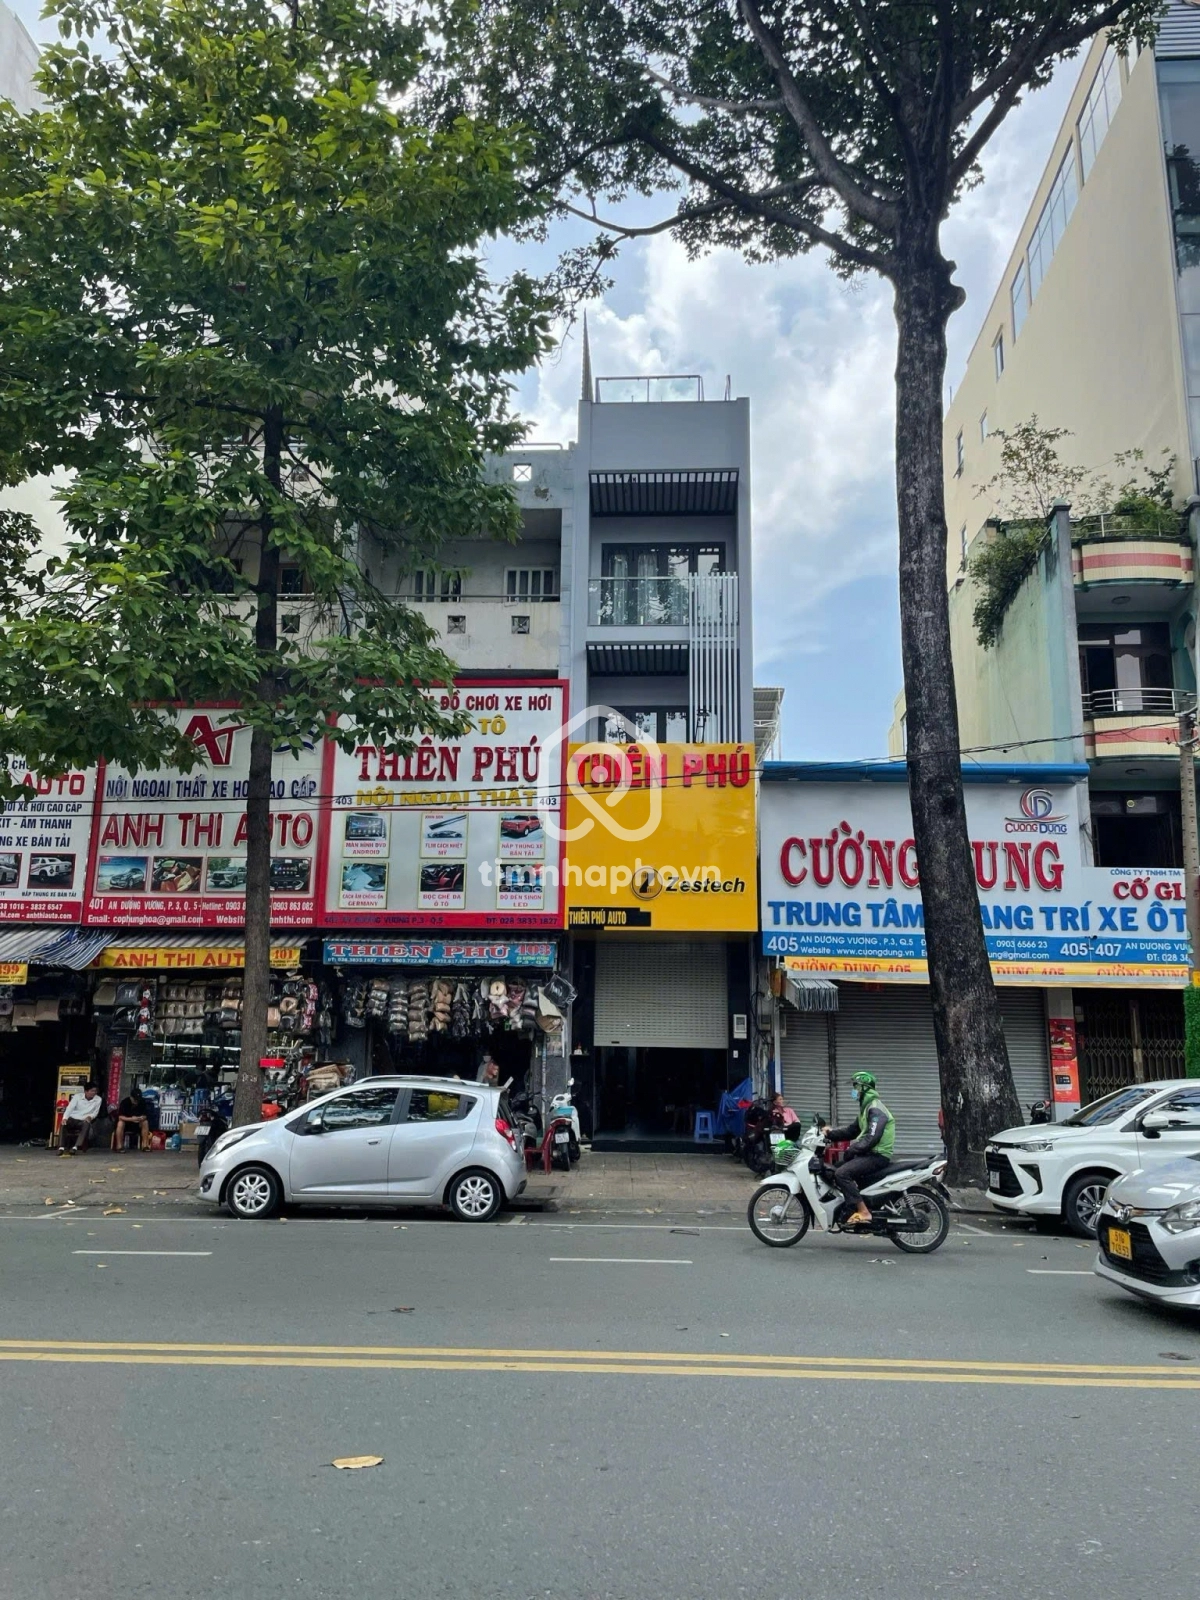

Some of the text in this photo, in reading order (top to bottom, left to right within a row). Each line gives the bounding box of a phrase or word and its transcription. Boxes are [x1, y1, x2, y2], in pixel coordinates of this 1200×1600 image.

[440, 689, 460, 711] ĐỒ
[466, 694, 500, 711] CHƠI
[505, 696, 523, 711] XE
[528, 694, 552, 711] HƠI
[478, 714, 507, 735] TÔ
[355, 735, 542, 783] THIÊN PHÚ
[573, 745, 751, 788] THIÊN PHÚ
[176, 774, 208, 798] THẤT
[212, 780, 228, 798] XE
[269, 780, 286, 799] AO
[334, 784, 557, 809] 403 NỘI NGOẠI THẤT 403
[18, 802, 29, 812] XE
[31, 803, 45, 812] HƠI
[47, 803, 63, 813] CAO
[21, 816, 72, 830] ÂM THANH
[101, 813, 164, 847] ANH
[178, 812, 222, 847] THI
[15, 837, 29, 848] XE
[55, 833, 71, 848] TẢI
[780, 821, 1065, 892] CƯỜNG UNG
[1110, 868, 1132, 876] CÔNG
[665, 875, 746, 894] Zestech
[1112, 877, 1187, 900] CỐ GI
[30, 903, 46, 911] 3832
[89, 898, 104, 910] 401
[108, 901, 118, 910] AN
[168, 901, 174, 910] P.
[175, 901, 181, 911] 3,
[184, 901, 191, 911] Q.
[193, 902, 198, 910] 5
[202, 902, 224, 910] Hotline:
[225, 902, 242, 911] 0903
[273, 902, 314, 911] 0903 863 082
[87, 914, 111, 923] Email:
[113, 915, 204, 925] cophunghoa@gmail.com
[500, 917, 515, 925] 028
[517, 917, 537, 925] 3833
[540, 917, 557, 925] 1827
[569, 908, 627, 925] THIÊN PHÚ AUTO
[767, 901, 861, 927] TRUNG
[866, 897, 925, 928] TÂM
[1039, 900, 1093, 931] TRÍ
[1097, 907, 1139, 931] XE
[328, 943, 511, 959] THIÊN PHÚ
[515, 944, 552, 956] 403
[767, 935, 799, 953] 405
[800, 936, 813, 944] AN
[900, 938, 914, 946] Q.5
[996, 940, 1048, 949] 0903 6566 23
[1060, 942, 1122, 957] 405-407
[113, 953, 158, 967] ANH
[163, 953, 196, 967] THI
[202, 952, 246, 967] AUT
[800, 946, 831, 954] Website
[836, 947, 915, 958] www.cuongdung.vn
[988, 951, 1050, 960] ung@gmail.com
[1146, 953, 1160, 961] ĐT:
[1161, 953, 1178, 962] 028
